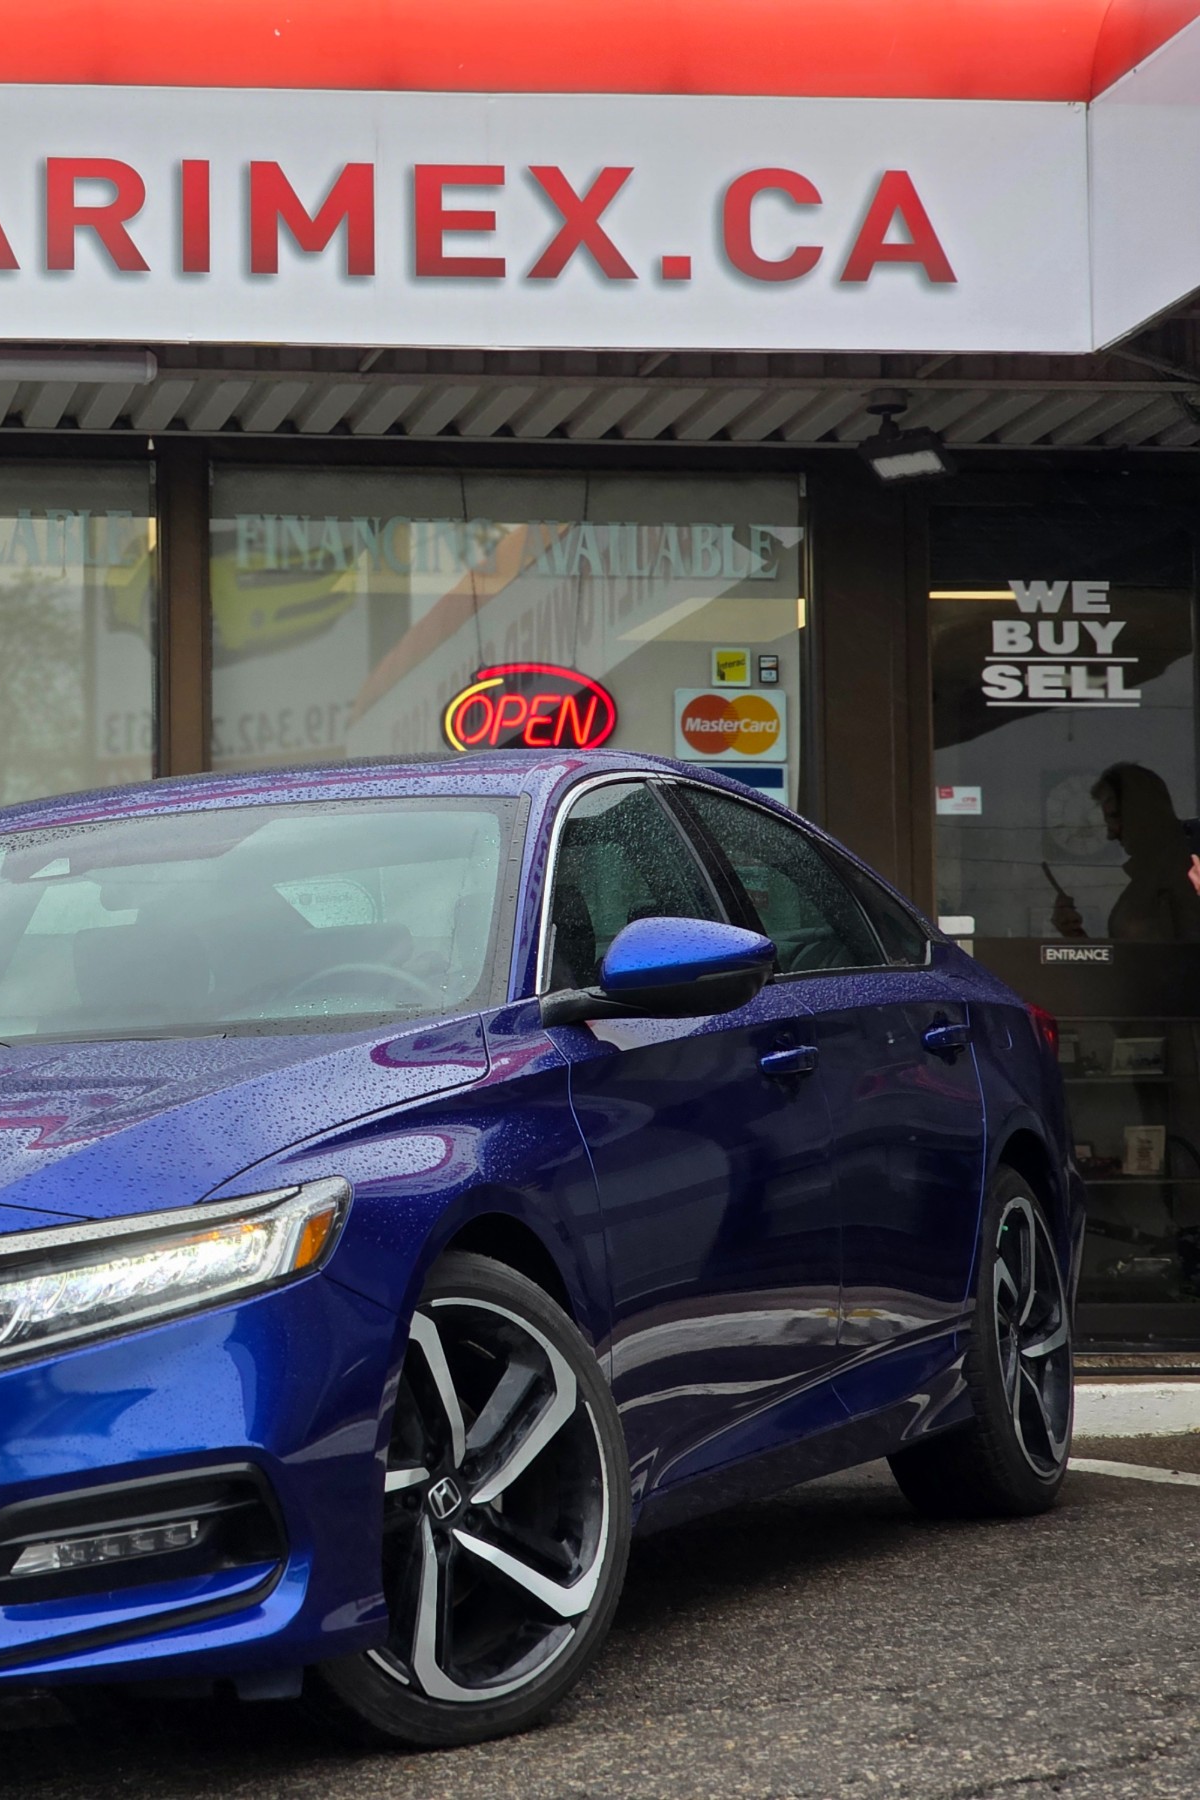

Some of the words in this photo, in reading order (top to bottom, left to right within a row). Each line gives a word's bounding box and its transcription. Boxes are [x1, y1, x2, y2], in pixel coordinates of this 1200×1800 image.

[235, 514, 500, 574] FINANCING
[518, 520, 779, 578] AVAILABLE
[1008, 580, 1111, 613] WE
[992, 620, 1127, 654] BUY
[981, 664, 1142, 699] SELL
[454, 694, 599, 746] OPEN
[684, 717, 778, 734] MasterCard
[1045, 948, 1109, 962] ENTRANCE
